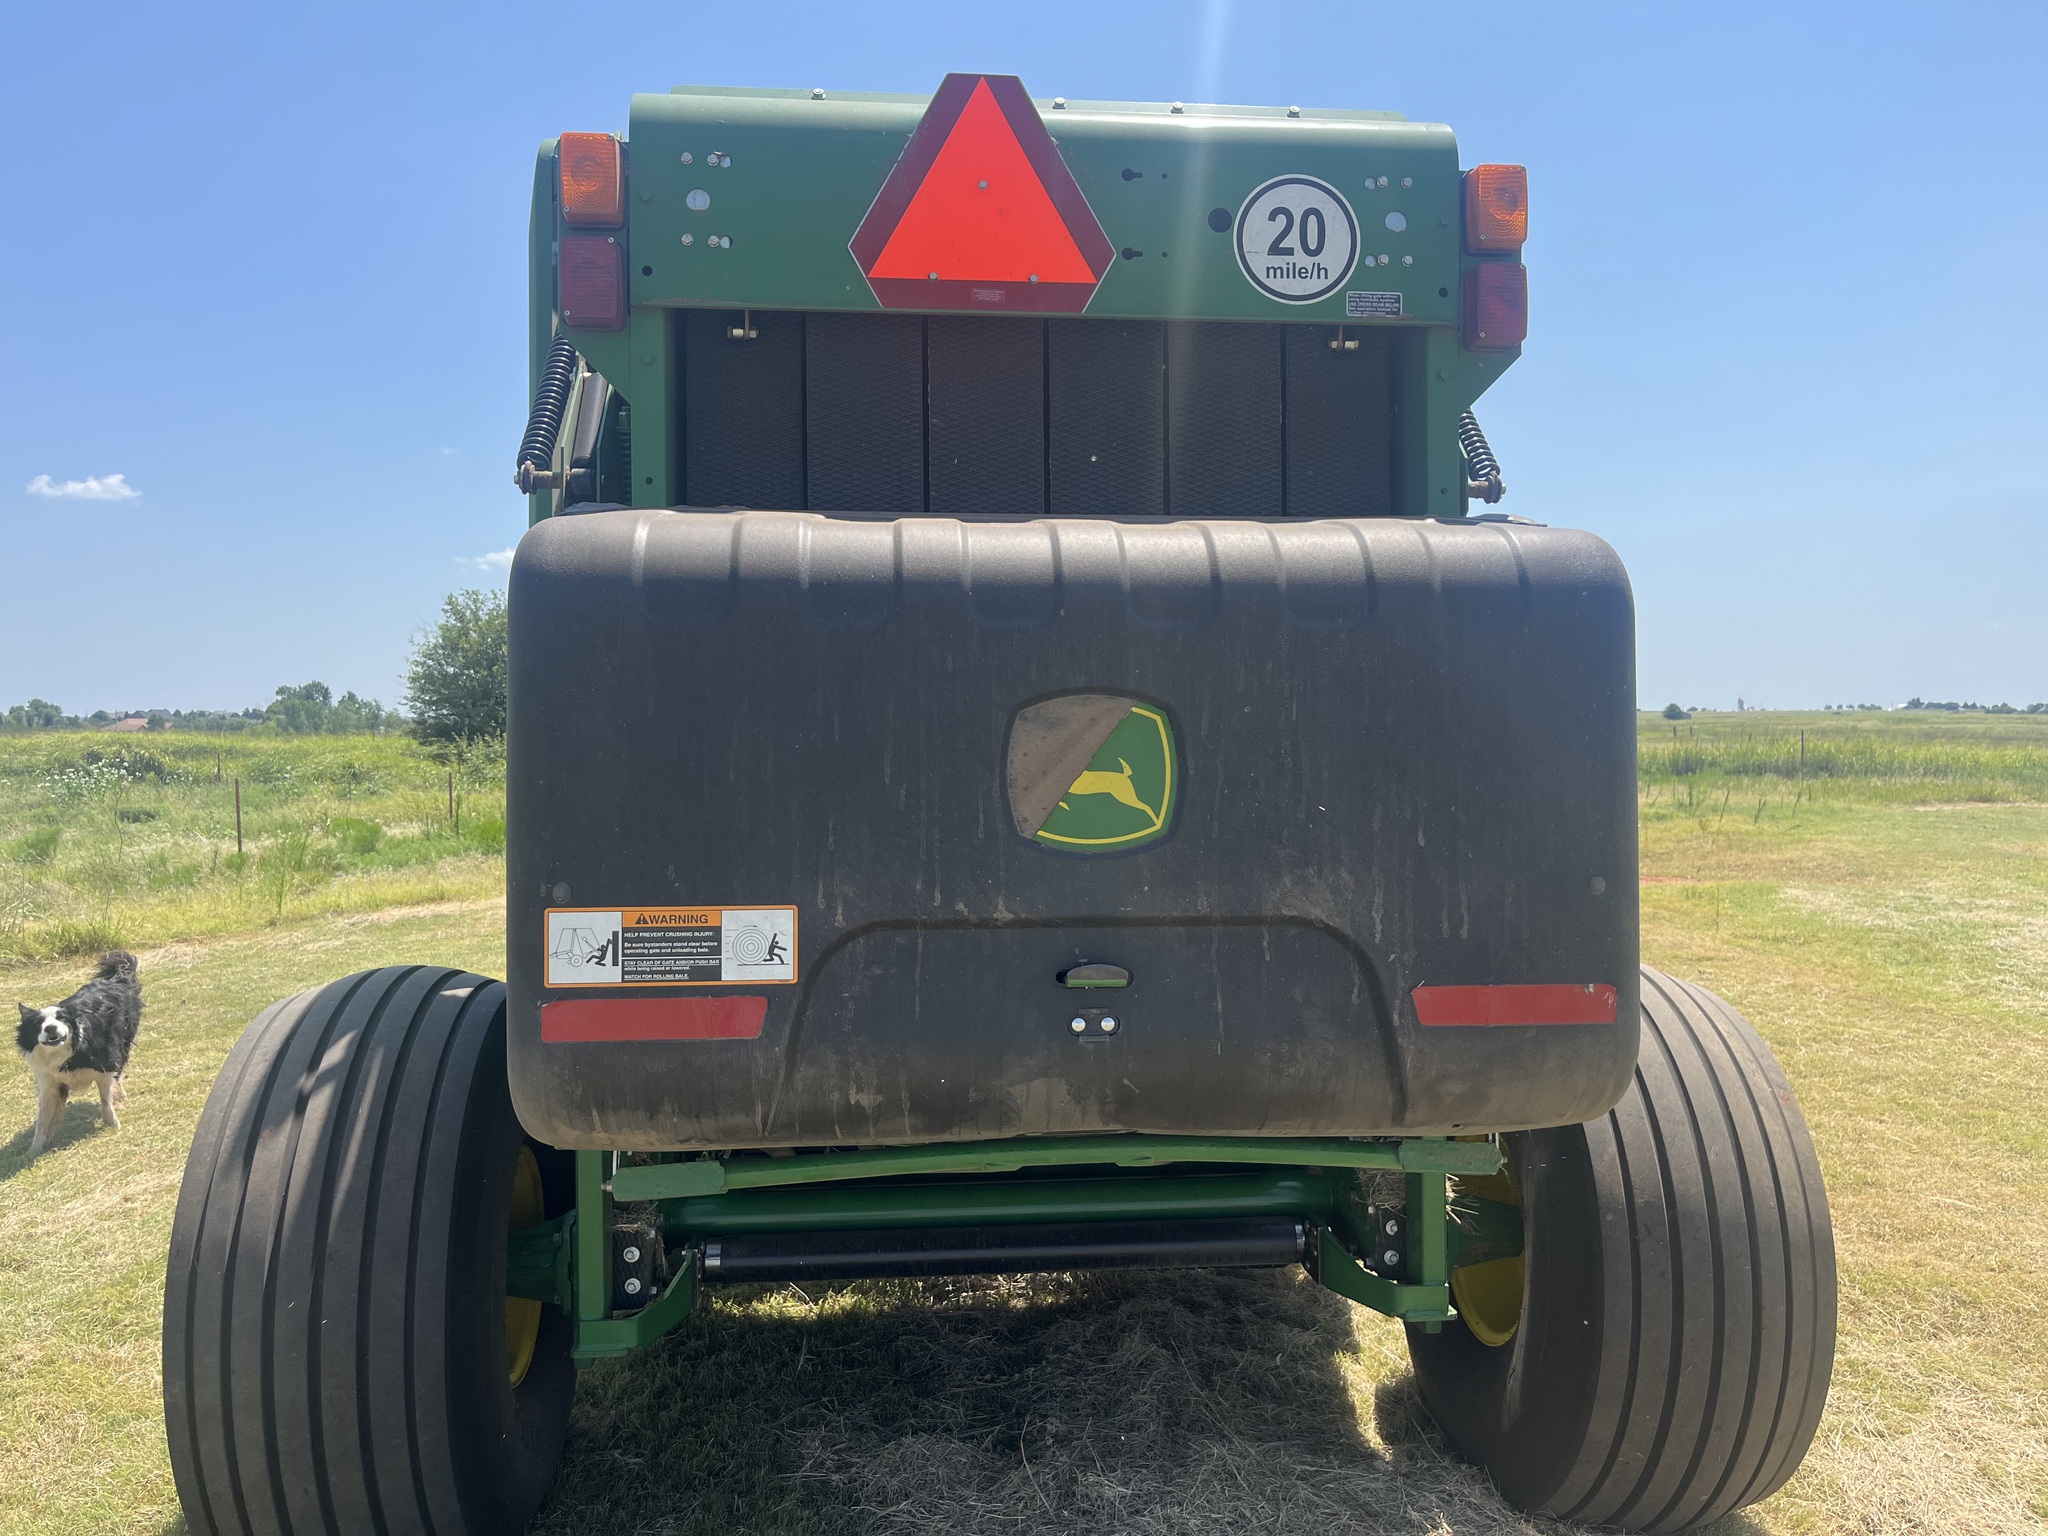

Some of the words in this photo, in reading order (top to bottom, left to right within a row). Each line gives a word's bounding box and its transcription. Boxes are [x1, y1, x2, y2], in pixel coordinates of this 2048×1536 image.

[1267, 206, 1325, 257] 20
[1266, 262, 1328, 279] mile/h
[649, 914, 708, 924] WARNING
